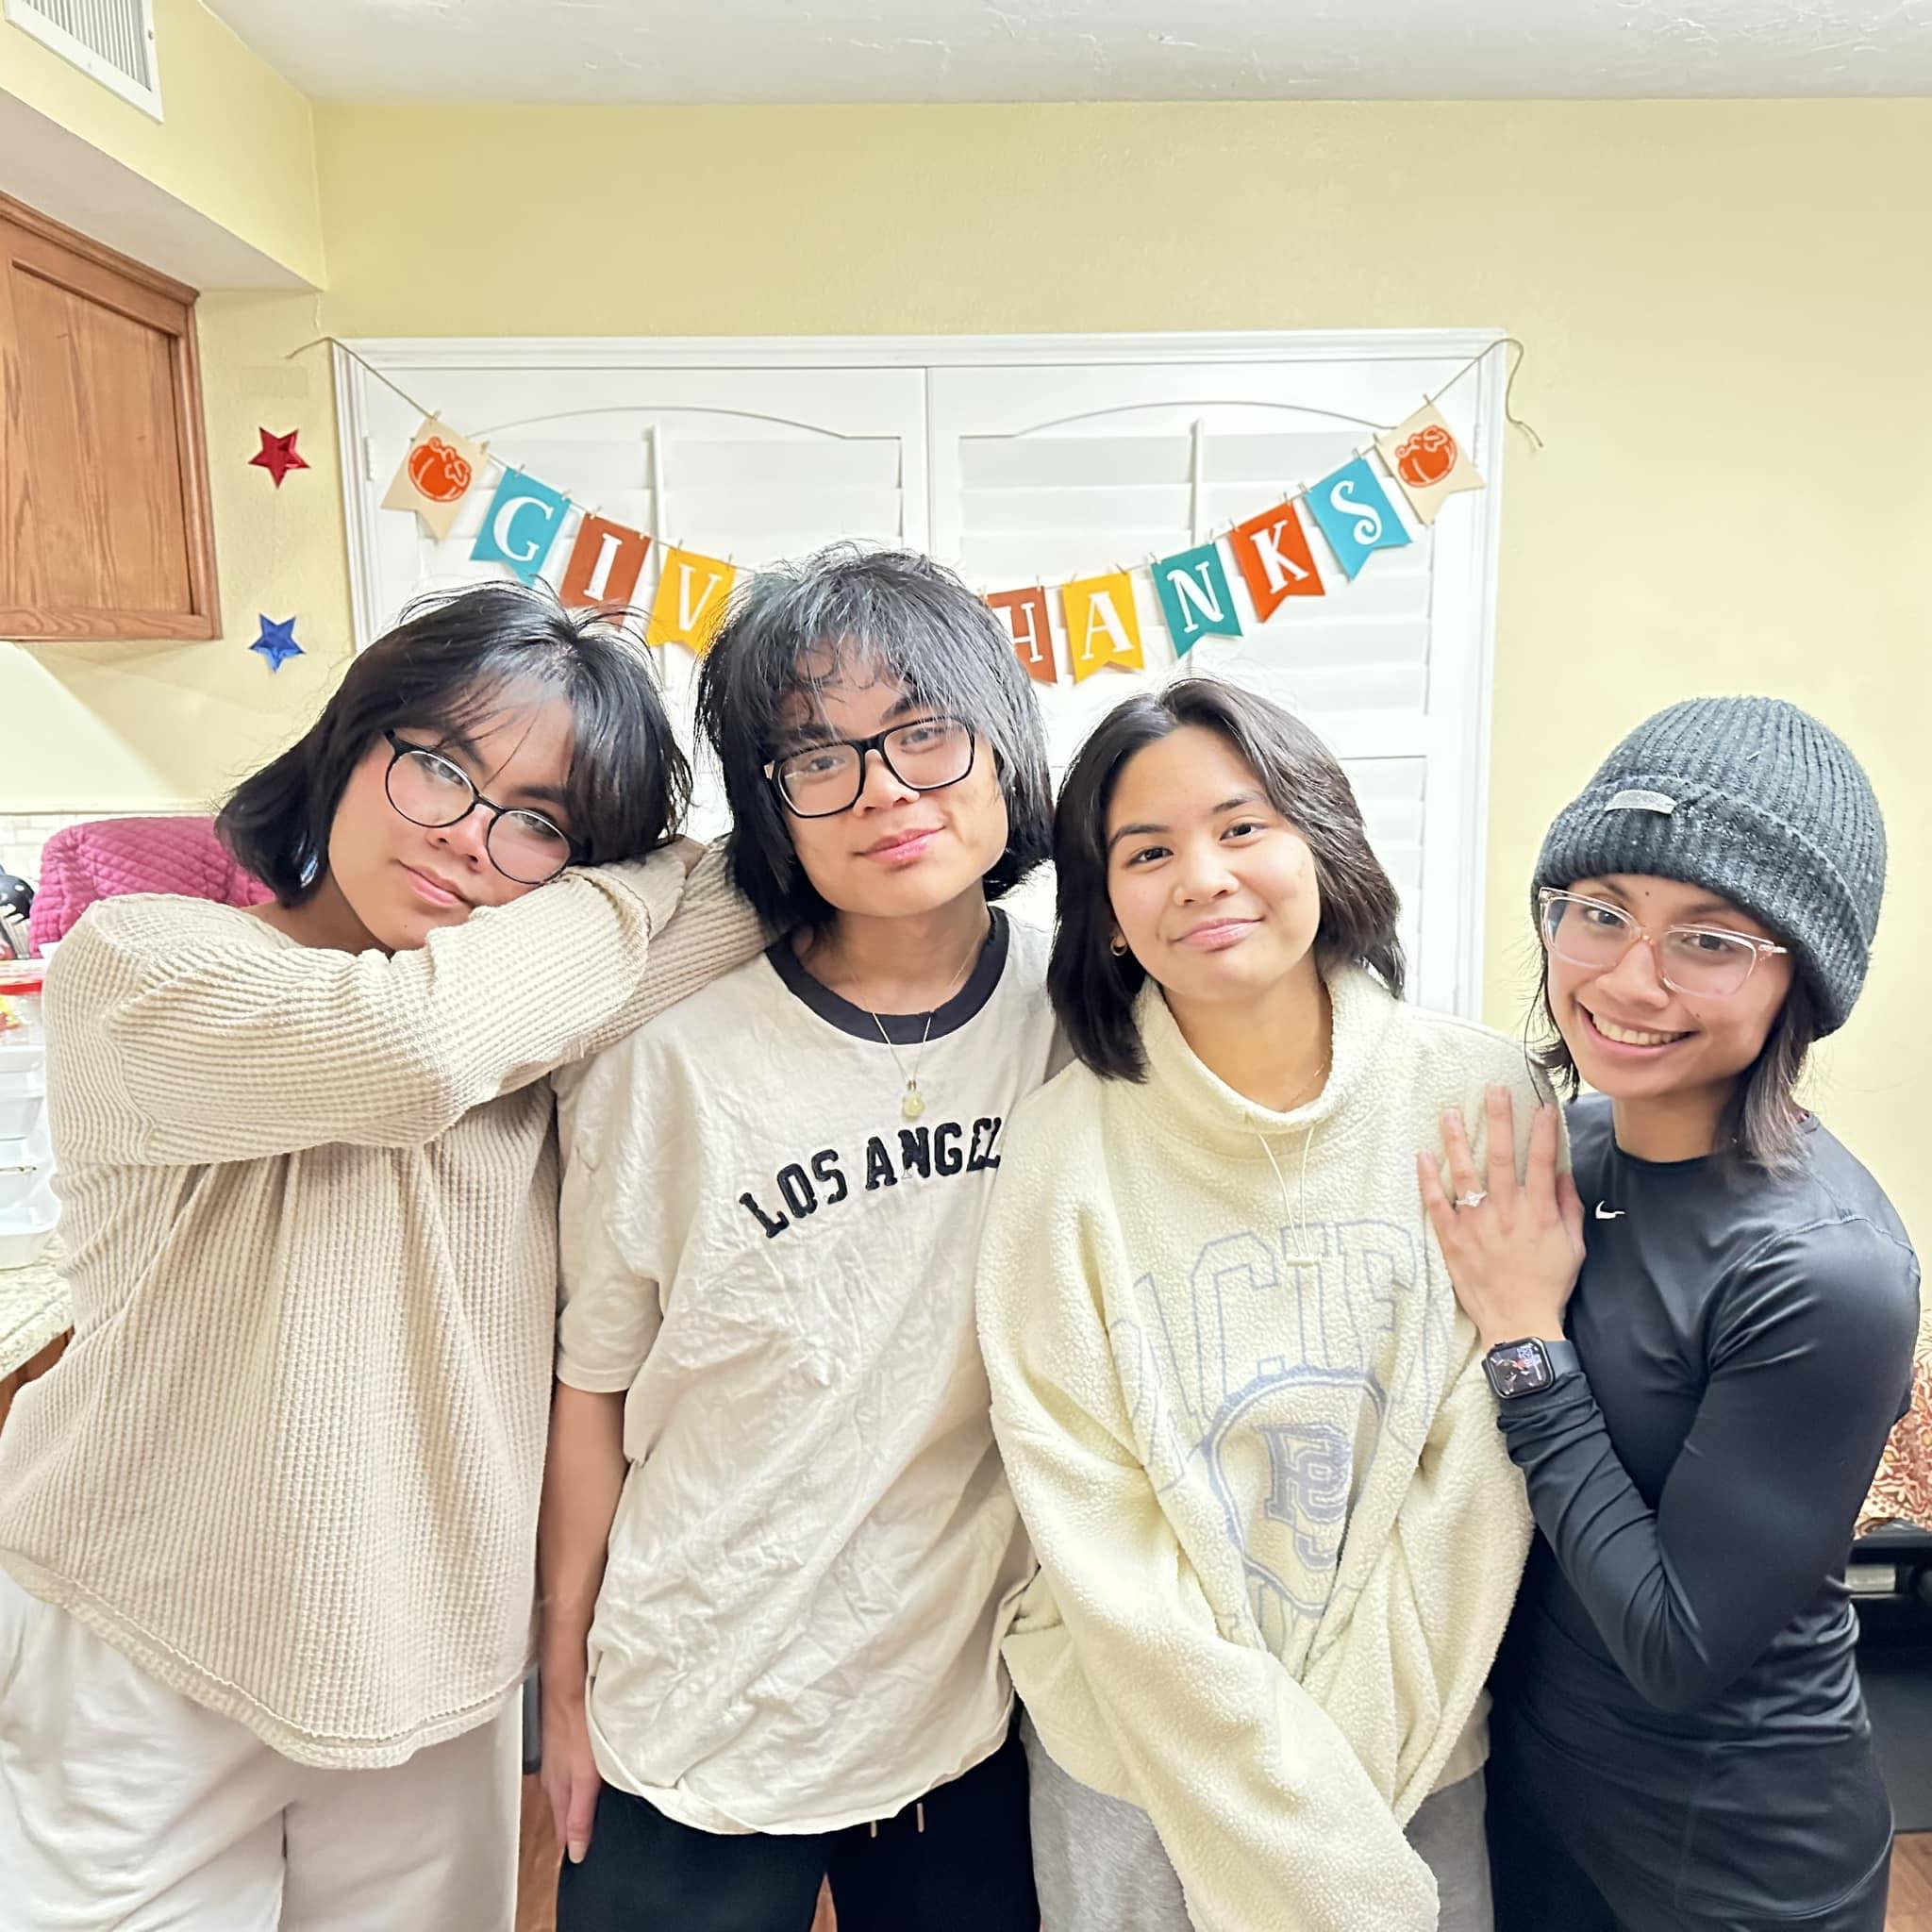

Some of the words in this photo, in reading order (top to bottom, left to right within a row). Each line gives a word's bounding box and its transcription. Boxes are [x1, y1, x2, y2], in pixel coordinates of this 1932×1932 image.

[492, 494, 723, 632] GIV
[991, 479, 1382, 663] HANKS
[739, 1148, 848, 1239] LOS
[865, 1117, 1001, 1190] ANGEL
